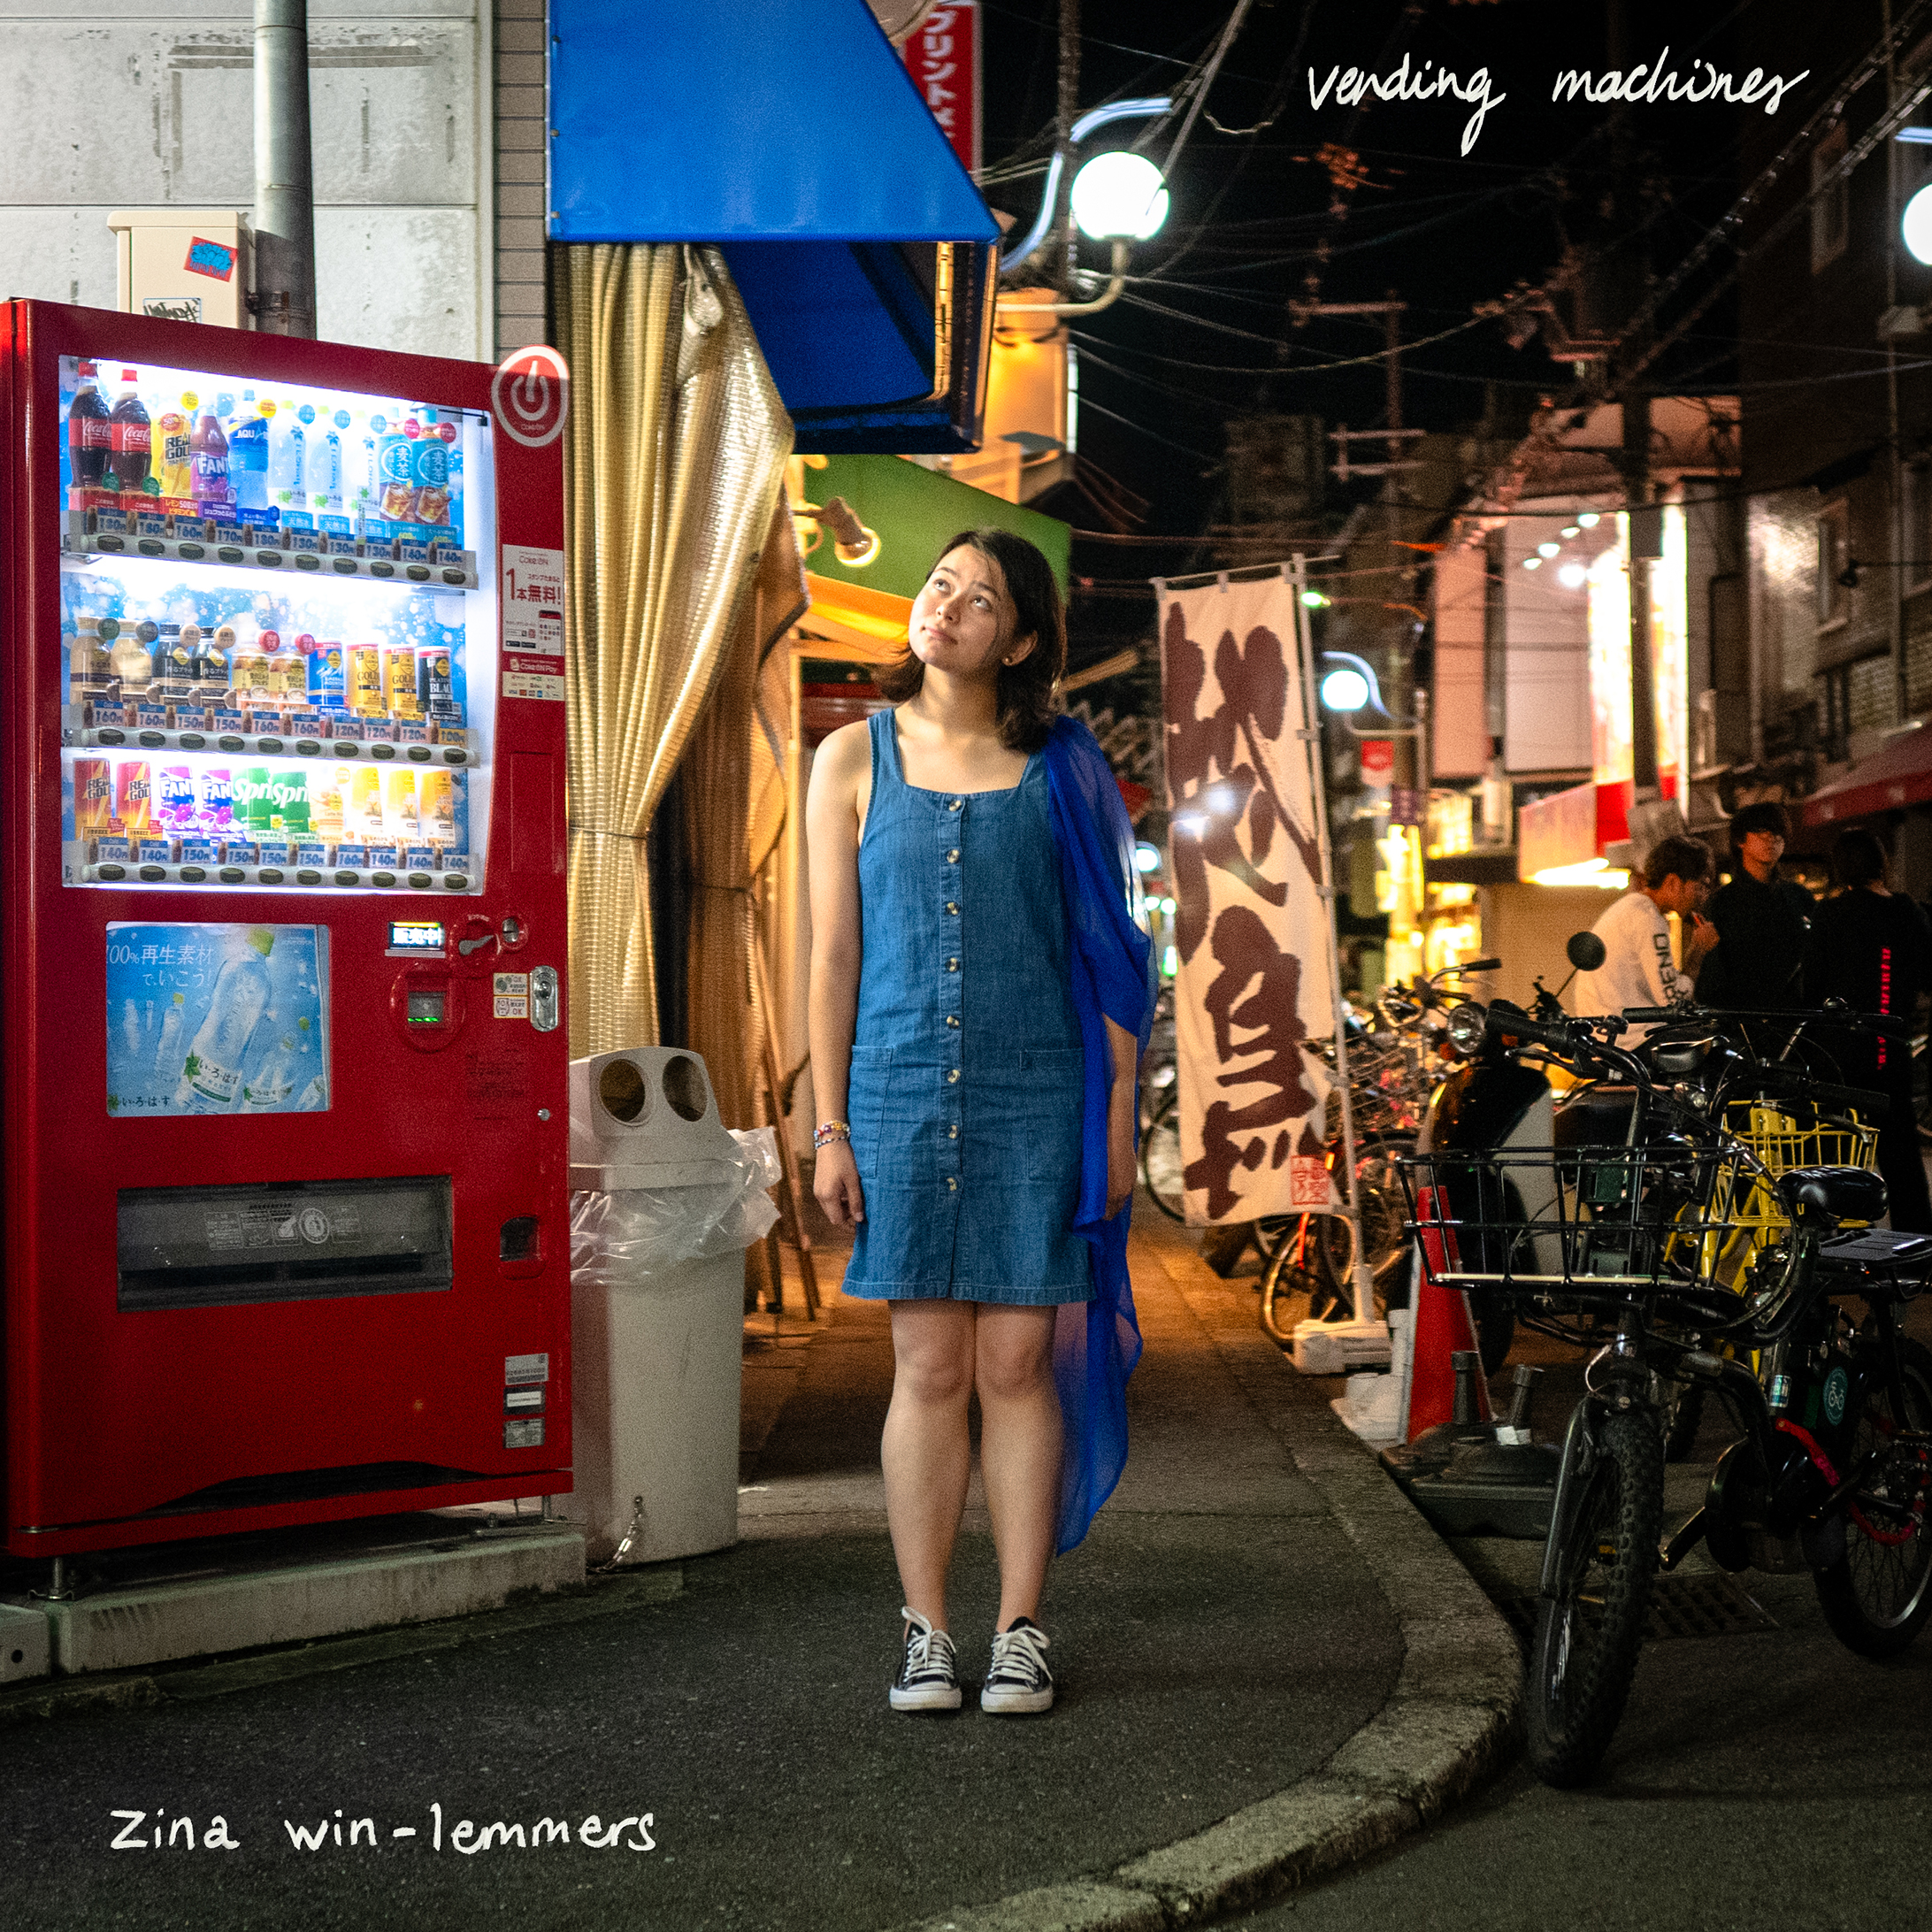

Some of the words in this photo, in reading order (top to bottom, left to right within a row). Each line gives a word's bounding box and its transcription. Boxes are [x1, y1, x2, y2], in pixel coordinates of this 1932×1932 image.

[396, 446, 410, 478] 麦茶
[432, 450, 445, 482] 麦茶
[106, 944, 213, 965] 00%再生素材
